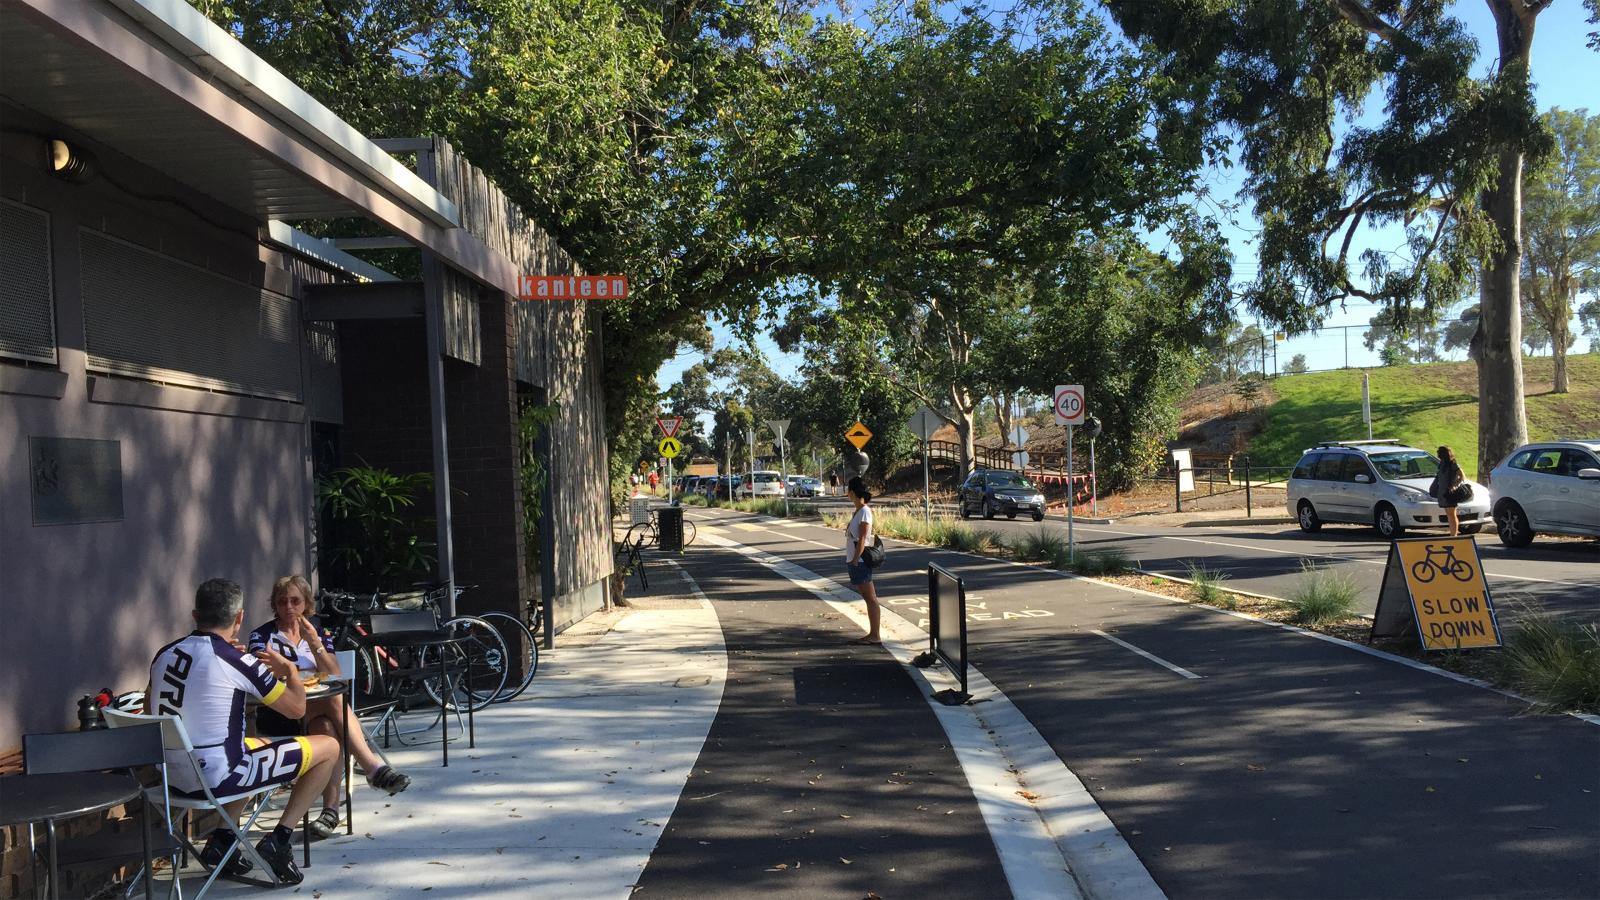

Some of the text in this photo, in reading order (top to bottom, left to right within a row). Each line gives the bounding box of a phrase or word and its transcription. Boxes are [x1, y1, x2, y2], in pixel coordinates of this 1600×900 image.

[521, 275, 624, 296] kanteen
[1060, 398, 1080, 411] 40
[1422, 597, 1480, 615] SLOW
[1429, 620, 1486, 638] DOWN
